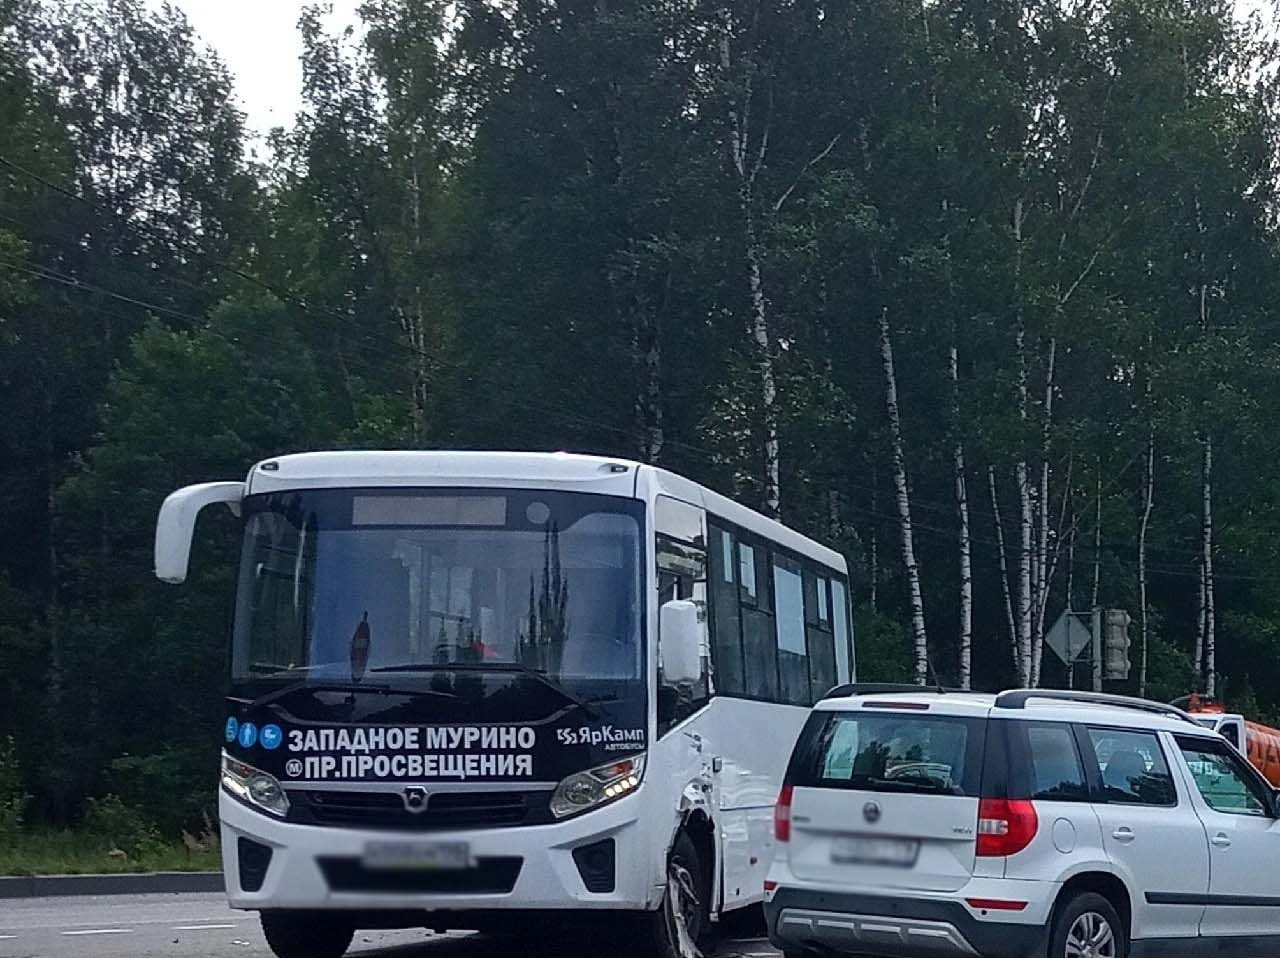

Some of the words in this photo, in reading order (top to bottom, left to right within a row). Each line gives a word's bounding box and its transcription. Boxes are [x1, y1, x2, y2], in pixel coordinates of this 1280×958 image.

[288, 727, 419, 754] ЗАПАДНОЕ
[426, 727, 536, 749] МУРИНО
[579, 725, 644, 746] ЯрКамп
[305, 754, 533, 780] ПР.ПРОСВЕЩЕНИЯ
